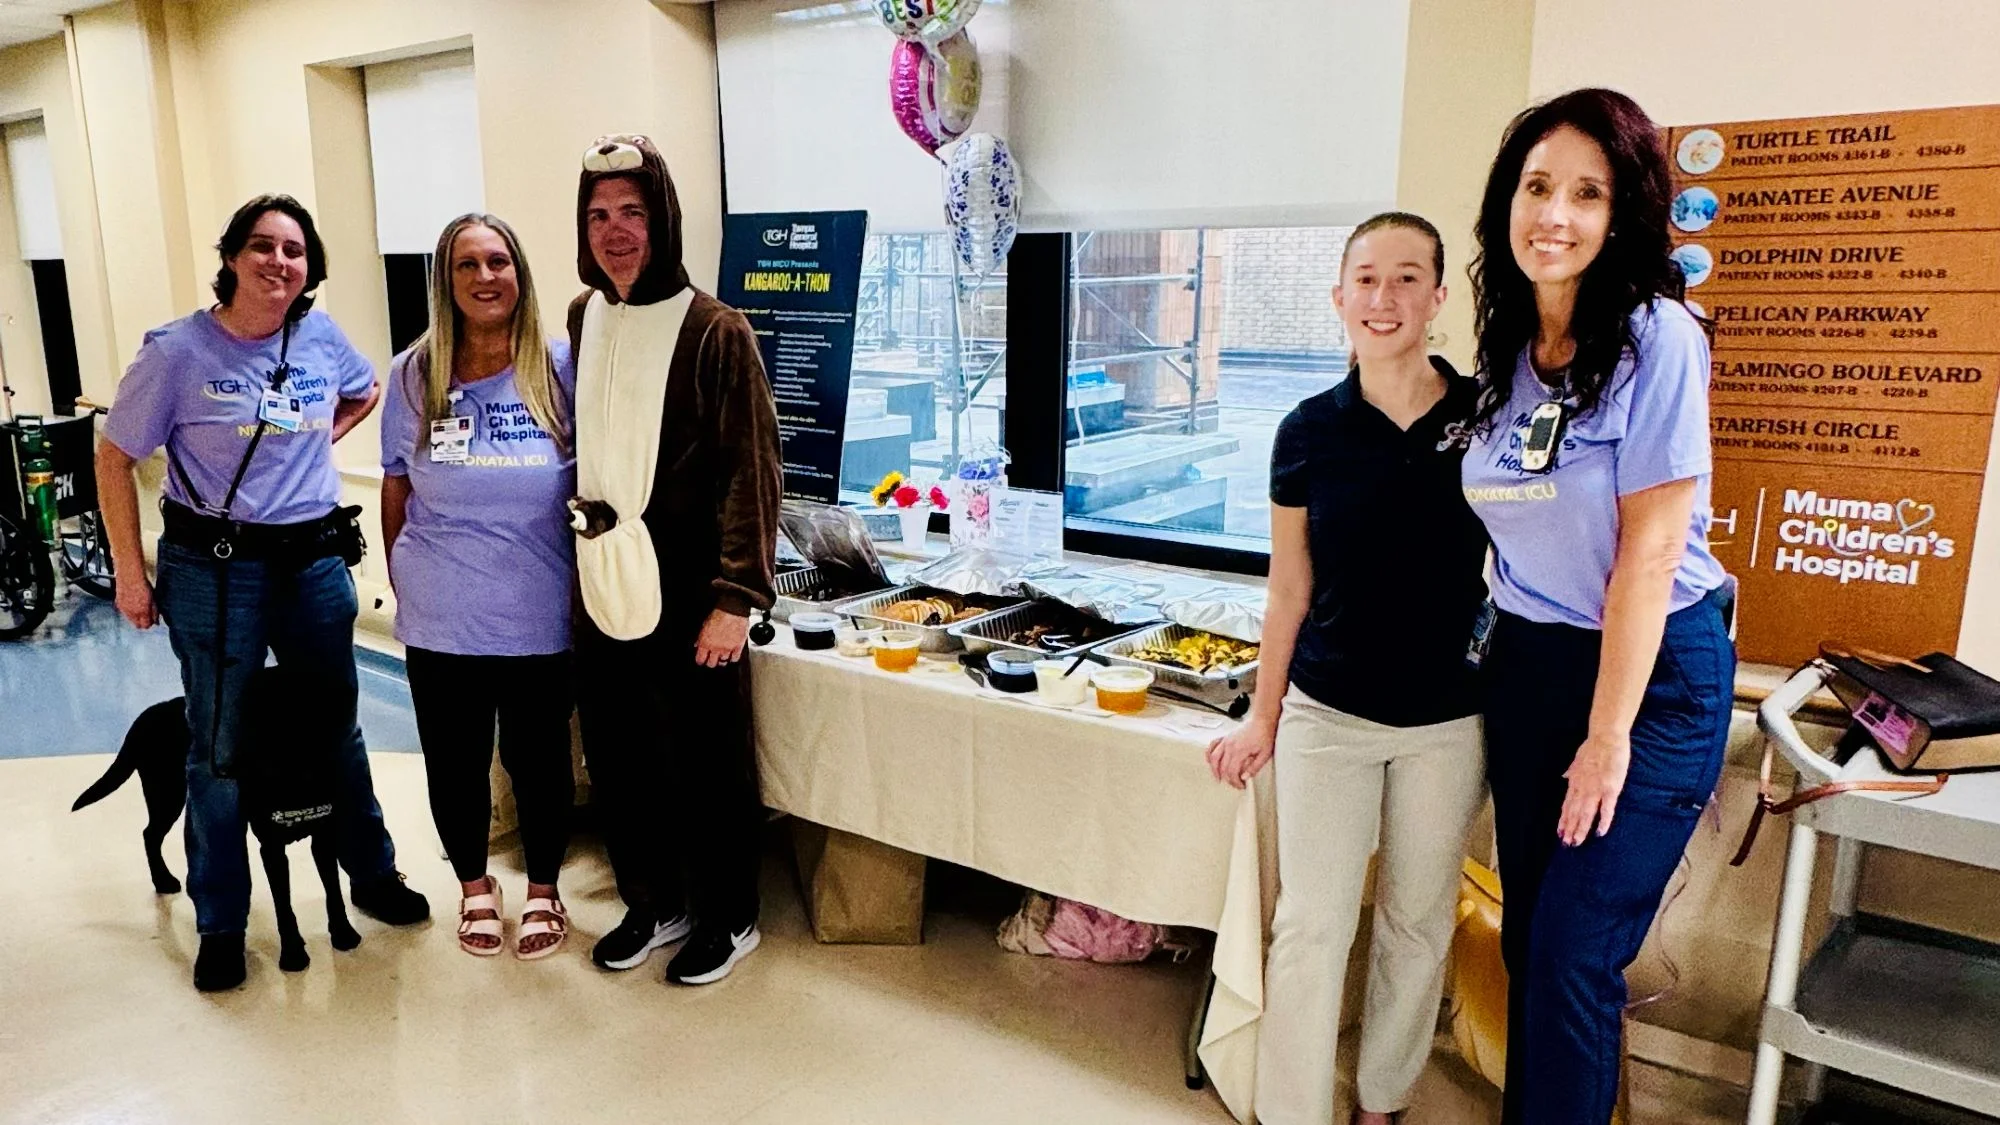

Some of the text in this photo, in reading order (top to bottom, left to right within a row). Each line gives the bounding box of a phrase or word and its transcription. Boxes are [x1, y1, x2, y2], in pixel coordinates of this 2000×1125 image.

[1733, 125, 1896, 150] TURTLE TRAIL
[1731, 154, 1784, 166] PATIENT
[1787, 152, 1839, 164] ROOMS
[1726, 184, 1940, 207] MANATEE AVENUE
[1724, 212, 1776, 224] PATIENT
[1779, 210, 1831, 222] ROOMS
[766, 229, 788, 241] TGH
[1720, 246, 1905, 265] DOLPHIN DRIVE
[744, 272, 832, 292] KANGAROO-A-THON
[1717, 268, 1770, 280] PATIENT
[1773, 268, 1823, 280] ROOMS
[1713, 305, 1930, 322] PELICAN PARKWAY
[1765, 326, 1816, 337] ROOMS
[1711, 360, 1983, 383] FLAMINGO BOULEVARD
[208, 379, 251, 394] TGH
[1758, 383, 1809, 394] ROOMS
[1812, 422, 1900, 441] CIRCLE
[1751, 439, 1801, 451] ROOMS
[464, 455, 548, 467] ONATAL ICU
[1525, 482, 1557, 500] ICU
[1783, 489, 1895, 522] Muma
[1779, 518, 1955, 558] Children's
[1775, 547, 1920, 585] Hospital
